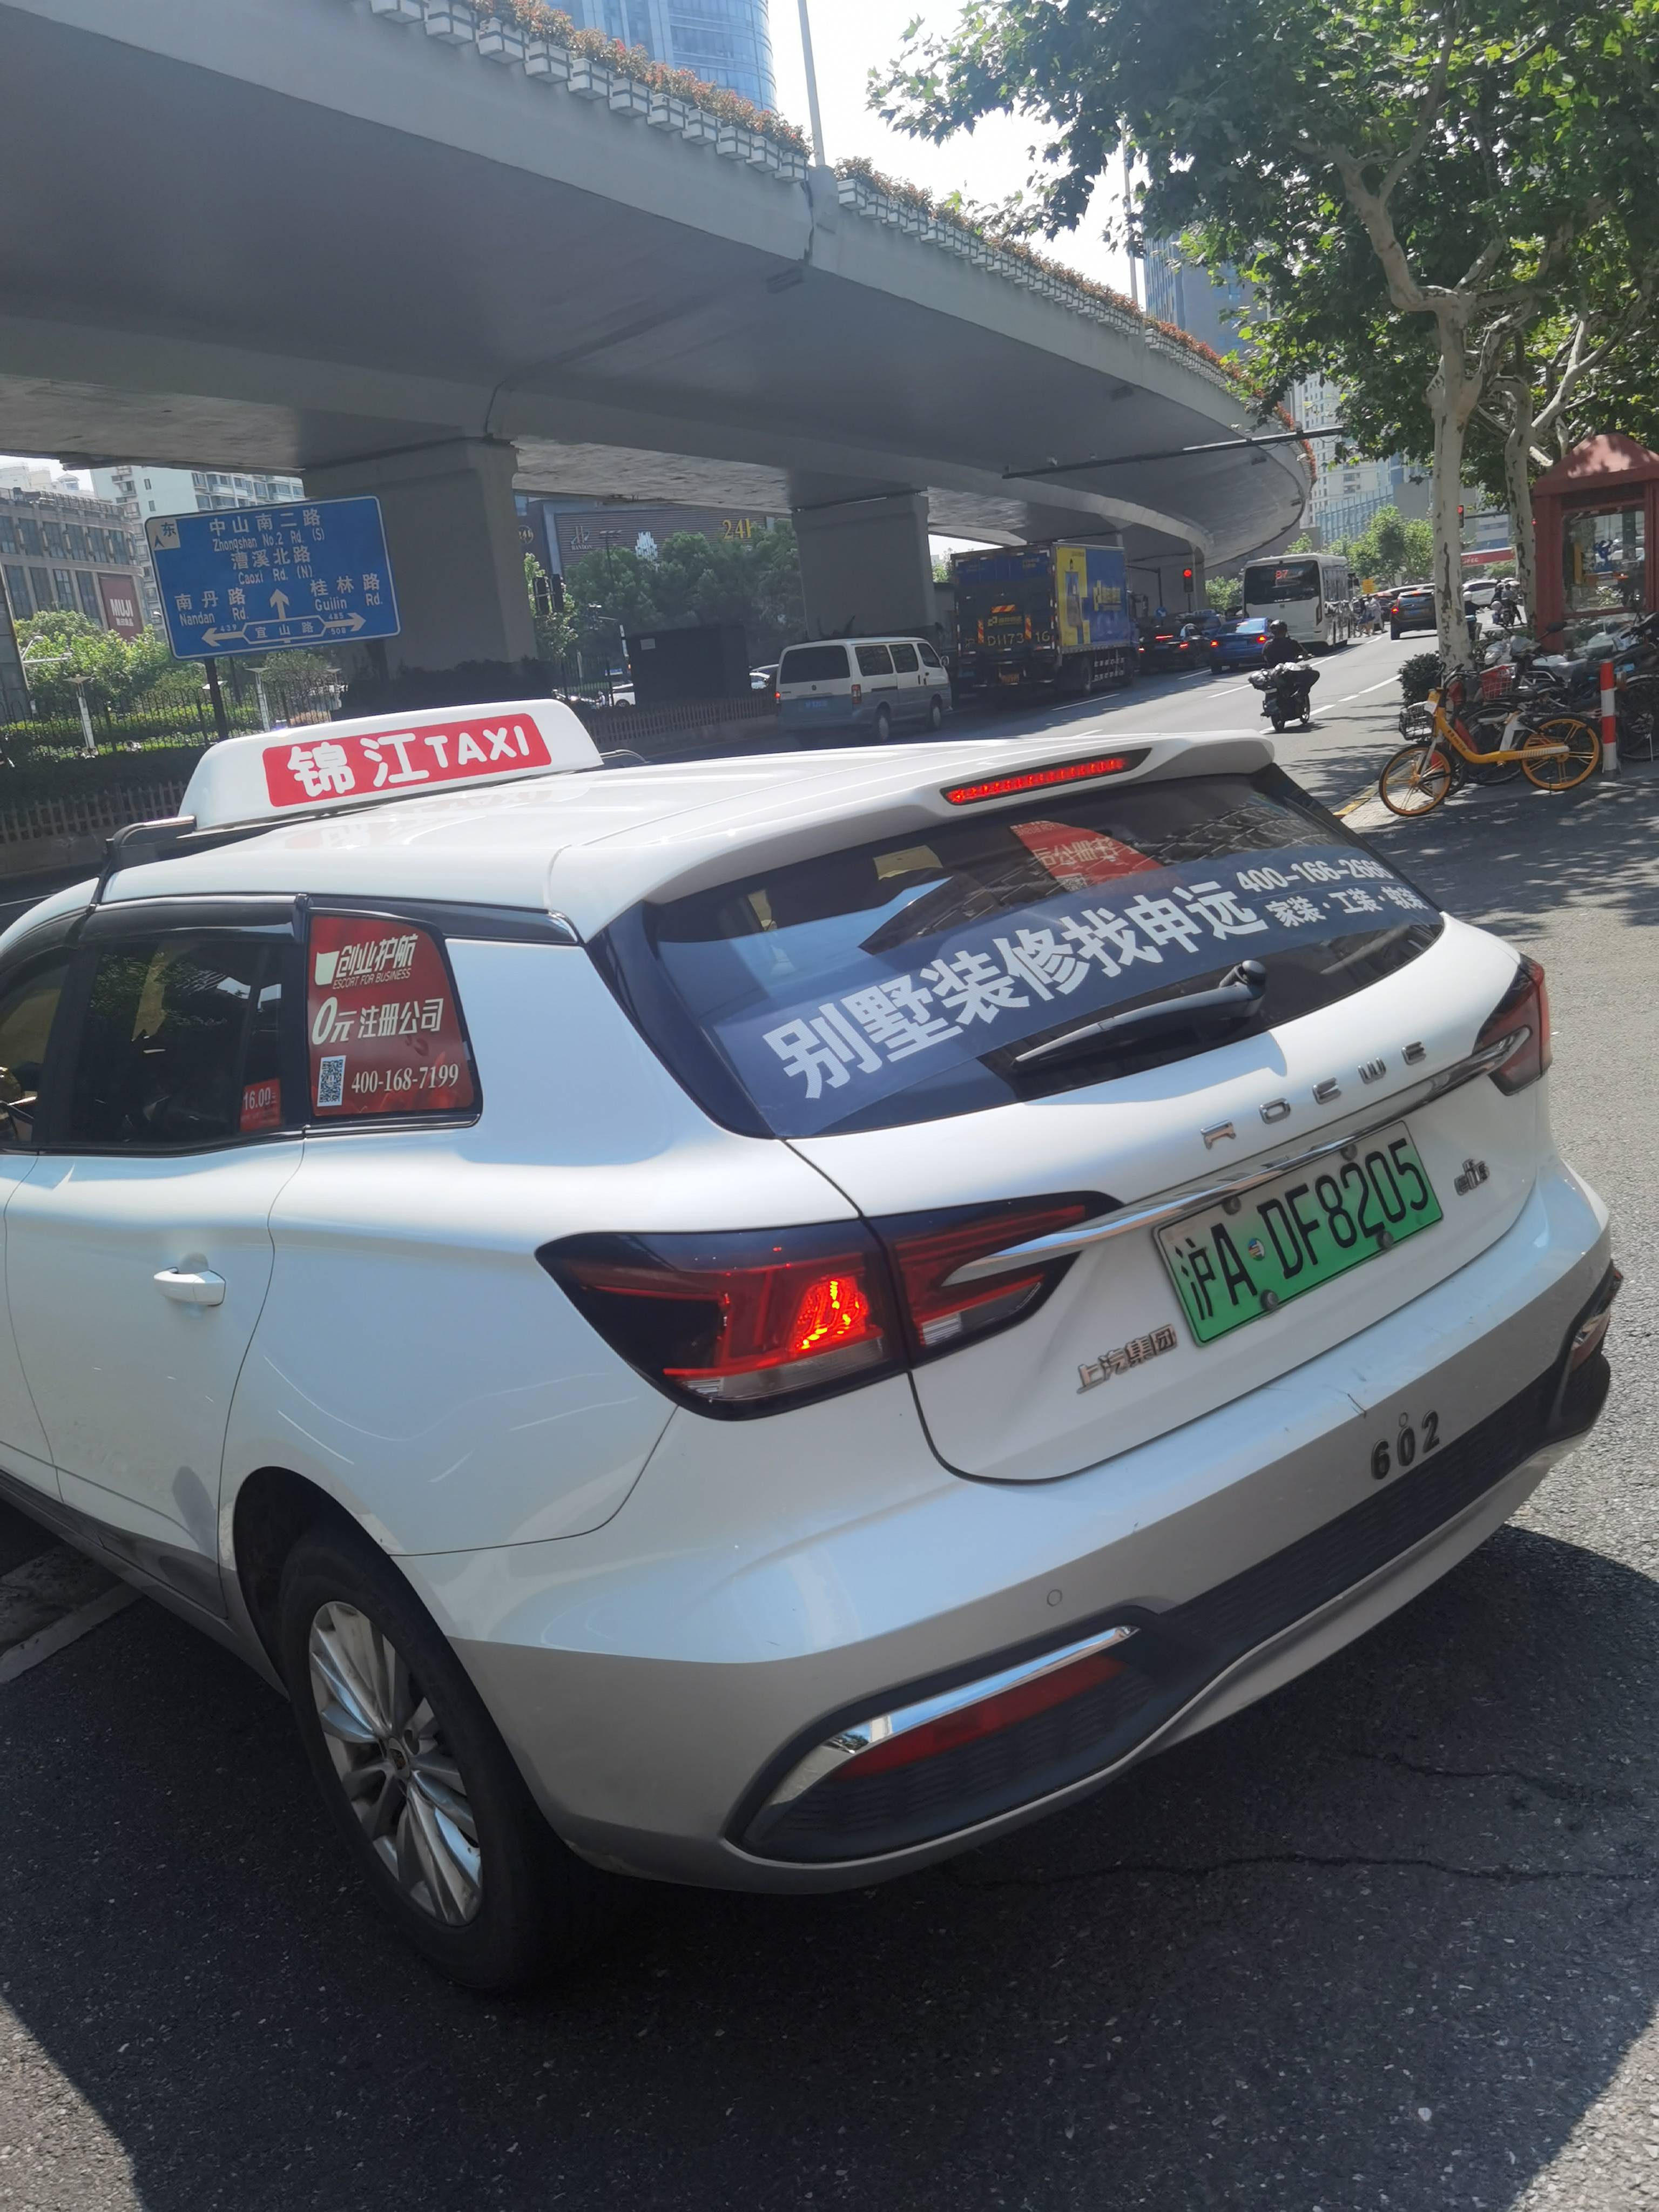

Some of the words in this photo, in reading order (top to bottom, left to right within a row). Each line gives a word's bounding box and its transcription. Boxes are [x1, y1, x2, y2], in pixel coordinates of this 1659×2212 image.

[160, 522, 177, 537] 东
[210, 508, 320, 536] 中山南二路
[213, 536, 257, 552] Zhongshan
[262, 532, 284, 547] No.2
[290, 530, 305, 544] Rd.
[312, 528, 325, 542] (S)
[231, 545, 311, 570] 漕溪北路
[238, 571, 264, 585] Caoxi
[273, 568, 288, 581] Rd.
[297, 565, 312, 579] (N)
[310, 572, 380, 597] 桂林路
[110, 598, 134, 617] MUJI
[174, 587, 245, 611] 南丹路
[315, 597, 347, 611] Guilin
[366, 593, 383, 606] Rd.
[179, 611, 215, 626] Nandan
[232, 608, 249, 621] Rd.
[255, 621, 314, 638] 宜山路
[287, 733, 430, 798] 锦江
[424, 724, 530, 768] TAXI
[1236, 859, 1394, 893] 400-166-2666
[335, 933, 419, 978] 创业护航
[333, 975, 360, 990] ESCORT
[360, 973, 375, 986] FOR
[375, 968, 412, 983] BUSINESS
[762, 880, 1270, 1099] 别墅装修找申远
[351, 1063, 460, 1094] 400-168-7199
[243, 1087, 271, 1111] 16.00
[1076, 1323, 1178, 1395] 上汽集团
[1370, 1410, 1441, 1480] 602
